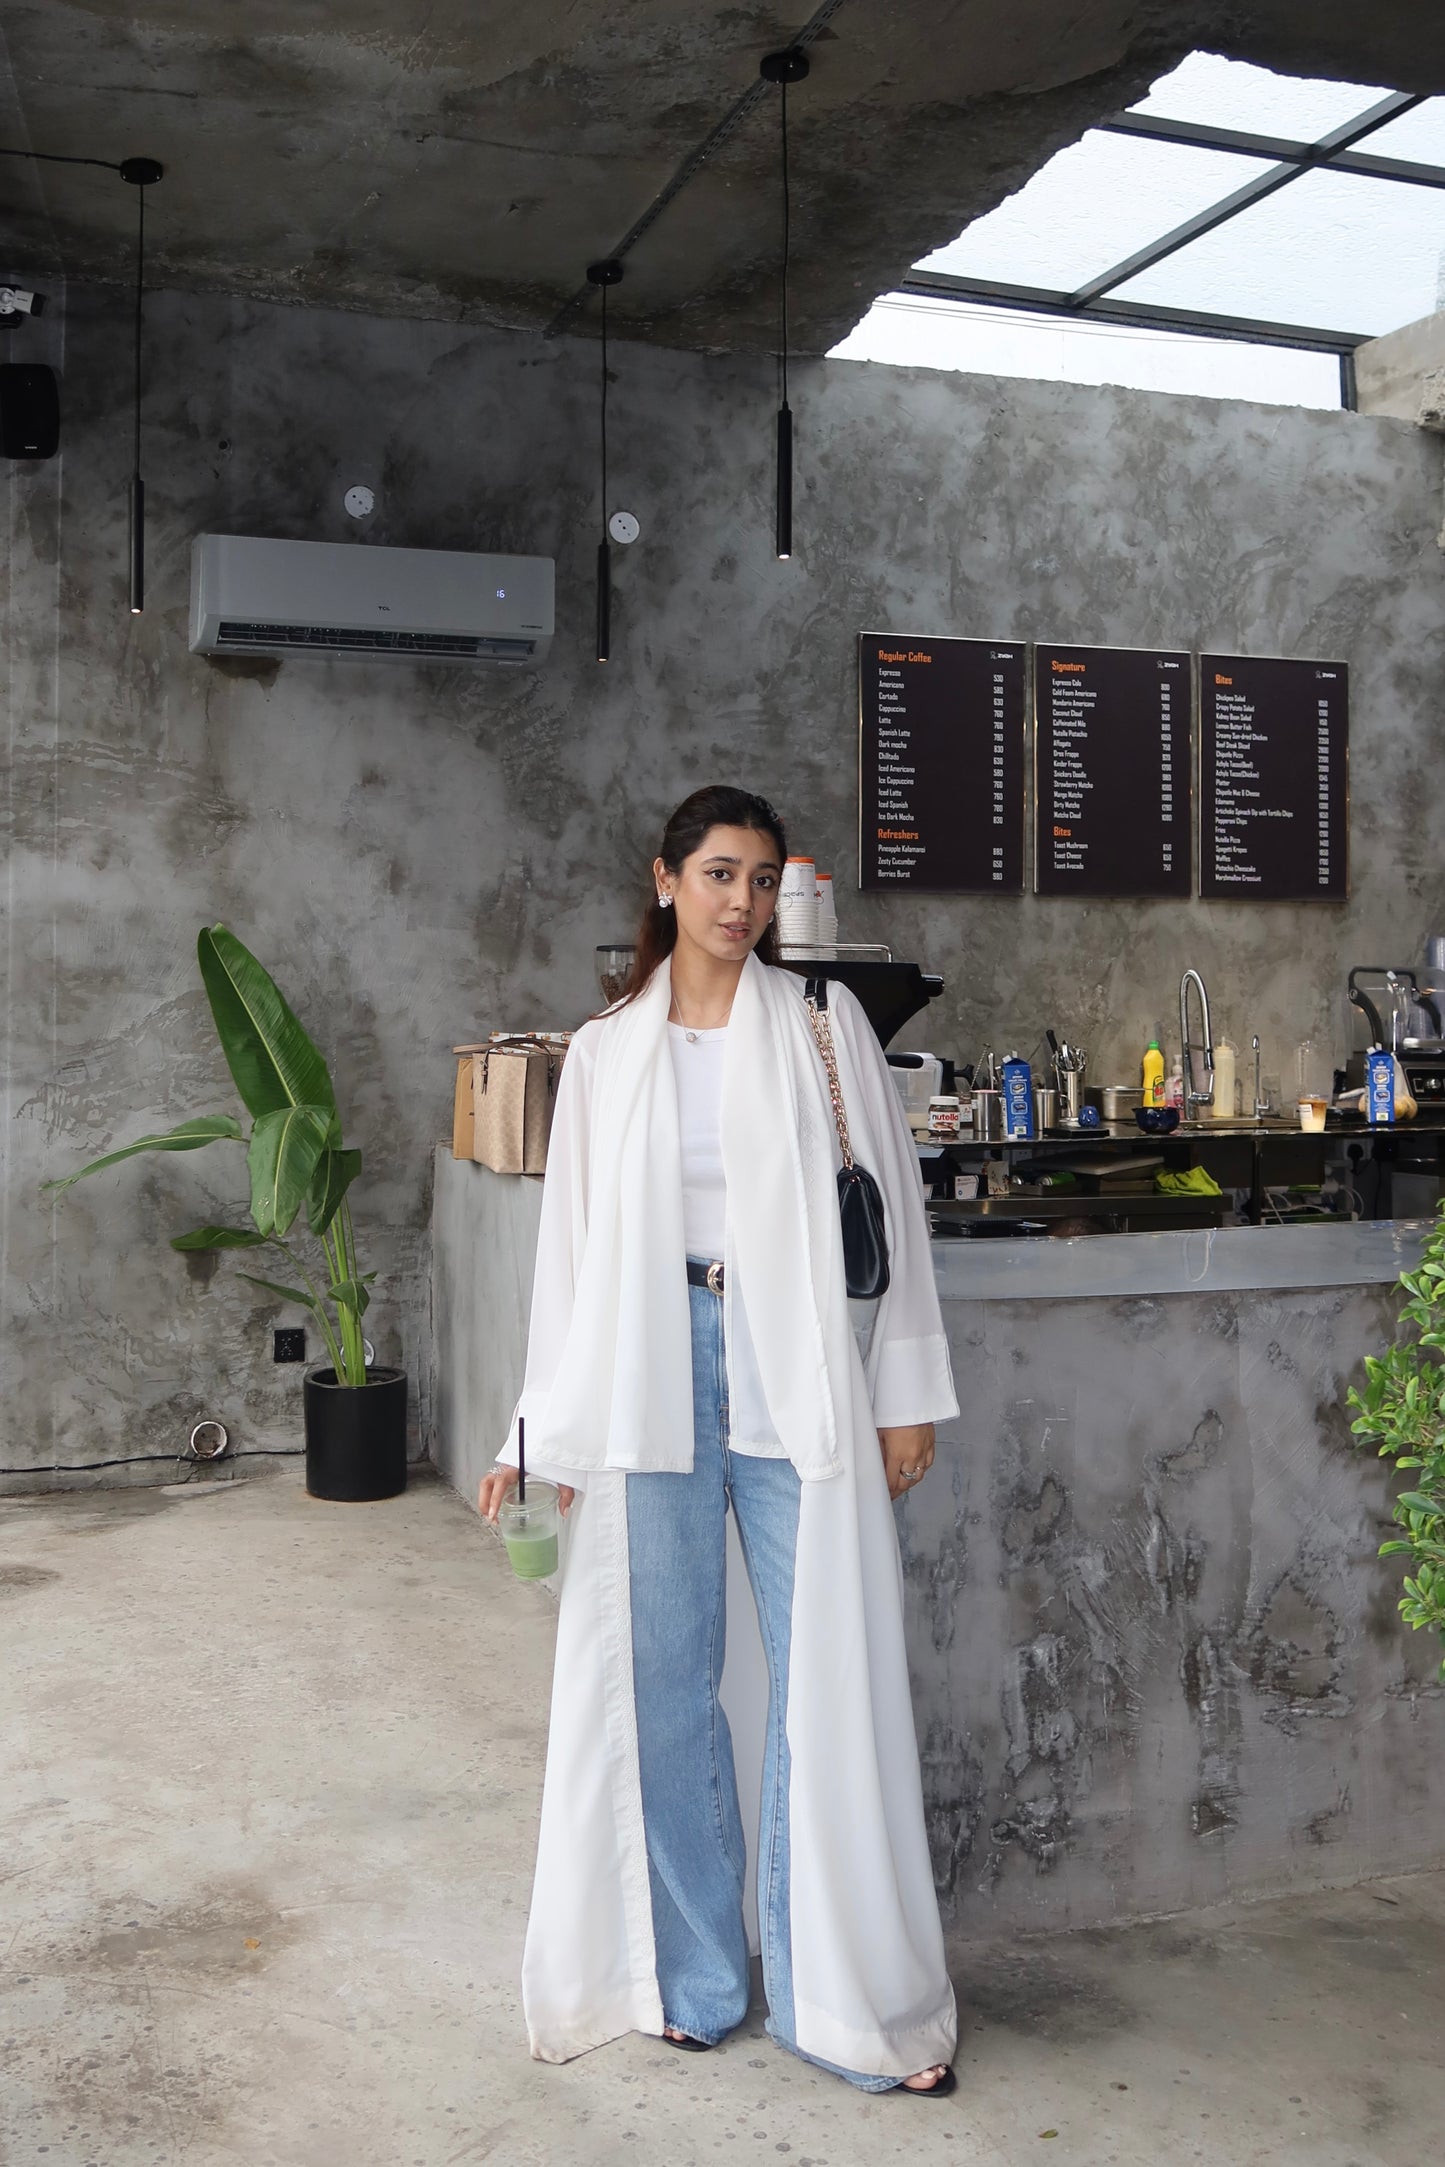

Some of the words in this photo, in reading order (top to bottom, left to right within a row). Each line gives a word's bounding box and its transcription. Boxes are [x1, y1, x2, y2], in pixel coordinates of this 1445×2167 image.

[496, 589, 506, 599] 16
[879, 650, 907, 663] Regular
[909, 652, 932, 663] Coffee
[1052, 661, 1086, 674] Signature
[1216, 674, 1232, 684] Bites
[879, 692, 898, 700] Cortado
[879, 704, 906, 714] Cappuccino
[879, 728, 898, 737] Spanish
[879, 740, 890, 748] Dark
[890, 765, 915, 773] Americano
[887, 777, 914, 786] Cappuccino
[890, 801, 908, 810] Spanish
[878, 829, 919, 840] Refreshers
[1054, 826, 1072, 836] Bites
[878, 844, 901, 853] Pineapple
[878, 857, 891, 865] Zesty
[897, 870, 910, 878] Burst
